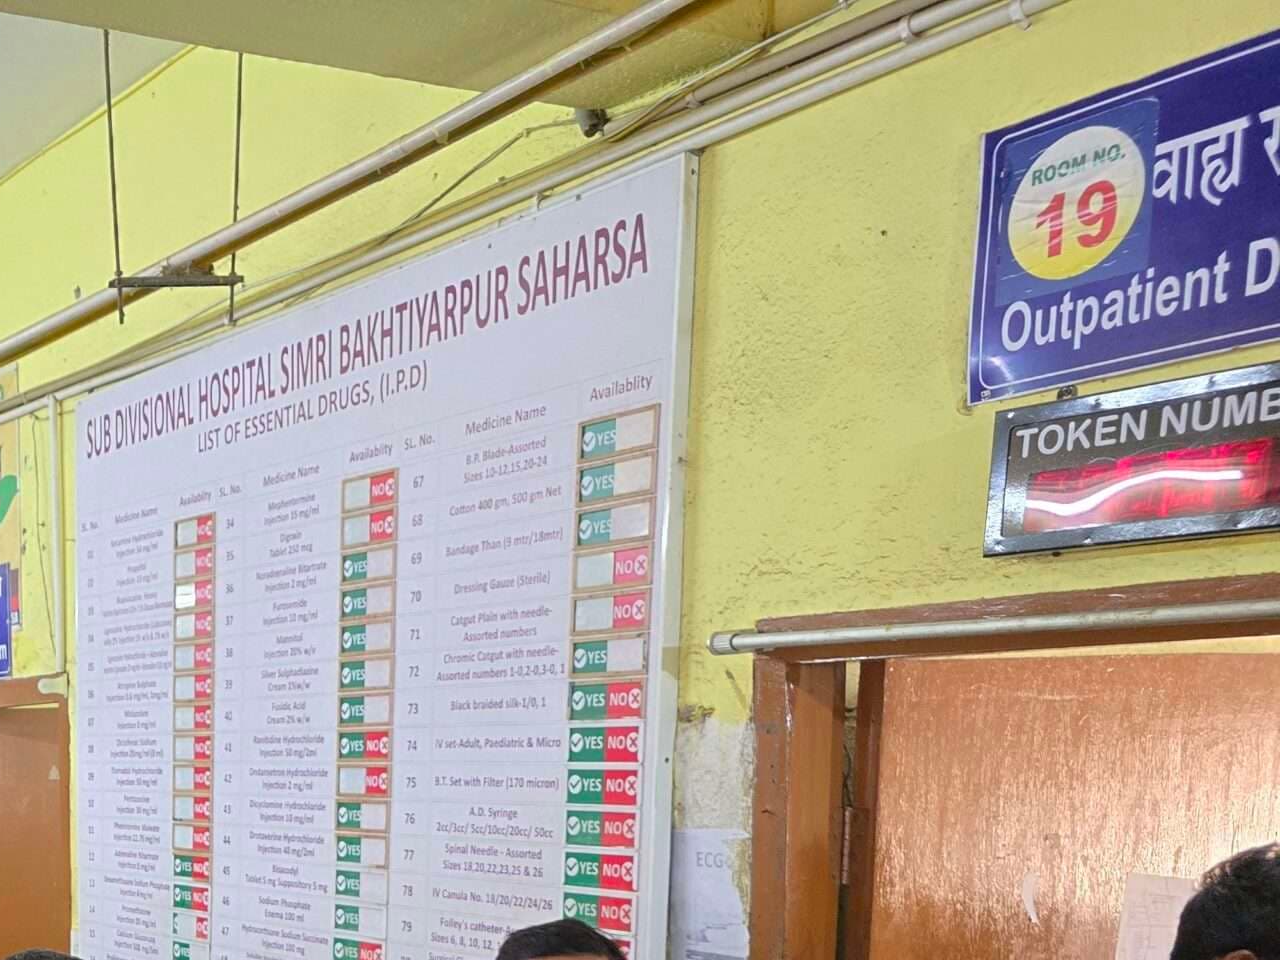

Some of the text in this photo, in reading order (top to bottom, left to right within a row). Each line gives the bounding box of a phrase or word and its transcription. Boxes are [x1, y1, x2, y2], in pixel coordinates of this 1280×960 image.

[1032, 143, 1126, 187] ROOM NO.
[1035, 179, 1118, 258] 19
[1001, 250, 1231, 352] Outpatient
[86, 212, 648, 460] SUB DIVISIONAL HOSPITAL SIMRI BAKHTIYARPUR SAHARSA
[198, 360, 428, 454] LIST OF ESSENTIAL DRUGS, (I.P.D)
[465, 405, 546, 436] Medicine Name
[596, 430, 616, 446] YES
[1016, 408, 1148, 459] TOKEN
[404, 433, 436, 451] SL. No.
[262, 464, 320, 487] Medicine Name
[412, 476, 424, 489] 67
[594, 475, 615, 490] YES
[372, 483, 385, 496] NO
[545, 485, 562, 498] Net
[371, 518, 385, 532] NO
[592, 519, 612, 535] YES
[411, 552, 422, 565] 69
[616, 558, 634, 574] NO
[410, 590, 422, 604] 70
[499, 607, 519, 620] with
[613, 602, 632, 618] NO
[409, 628, 420, 641] 71
[588, 650, 607, 665] YES
[409, 665, 420, 678] 72
[585, 692, 629, 708] YES NO
[408, 702, 419, 715] 73
[349, 739, 379, 752] YES NO
[407, 740, 417, 751] 74
[484, 737, 561, 749] Paediatric & Micro
[584, 735, 628, 750] YES NO
[406, 778, 417, 789] 75
[450, 777, 462, 788] Set
[463, 776, 481, 788] with
[483, 776, 504, 788] Filter
[582, 778, 625, 793] YES NO
[404, 813, 415, 825] 76
[488, 808, 518, 820] Syringe
[581, 819, 624, 835] YES NO
[404, 850, 415, 861] 77
[505, 847, 542, 861] Assorted
[579, 861, 622, 878] YES NO
[402, 885, 413, 897] 78
[576, 901, 620, 920] YES NO
[401, 920, 412, 932] 79
[344, 943, 373, 960] YES NO
